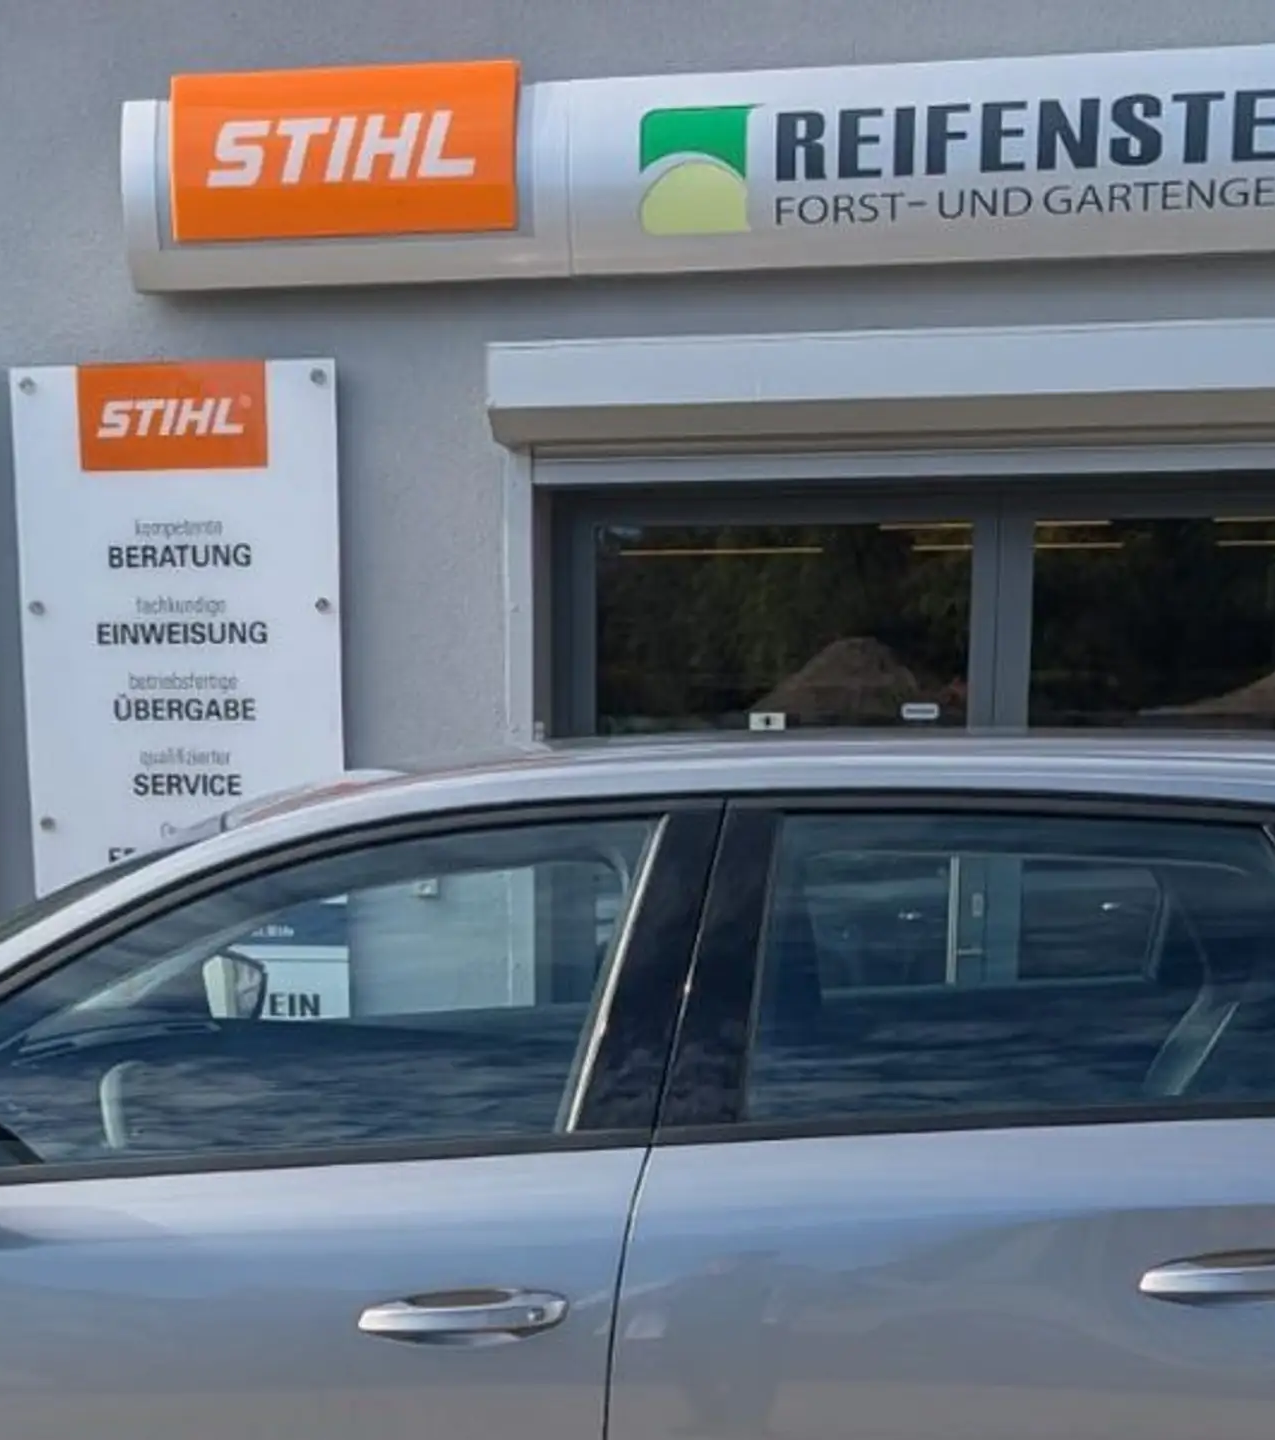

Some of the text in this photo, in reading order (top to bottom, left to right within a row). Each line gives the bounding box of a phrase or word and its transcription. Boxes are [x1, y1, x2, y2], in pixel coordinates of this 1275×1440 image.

[206, 109, 476, 189] STIHL
[774, 193, 927, 226] FORST-
[938, 187, 1035, 220] UND
[97, 397, 245, 439] STIHL
[108, 543, 252, 569] BERATUNG
[96, 620, 269, 646] EINWEISUNG
[113, 692, 256, 721] ÜBERGABE
[133, 773, 242, 796] SERVICE
